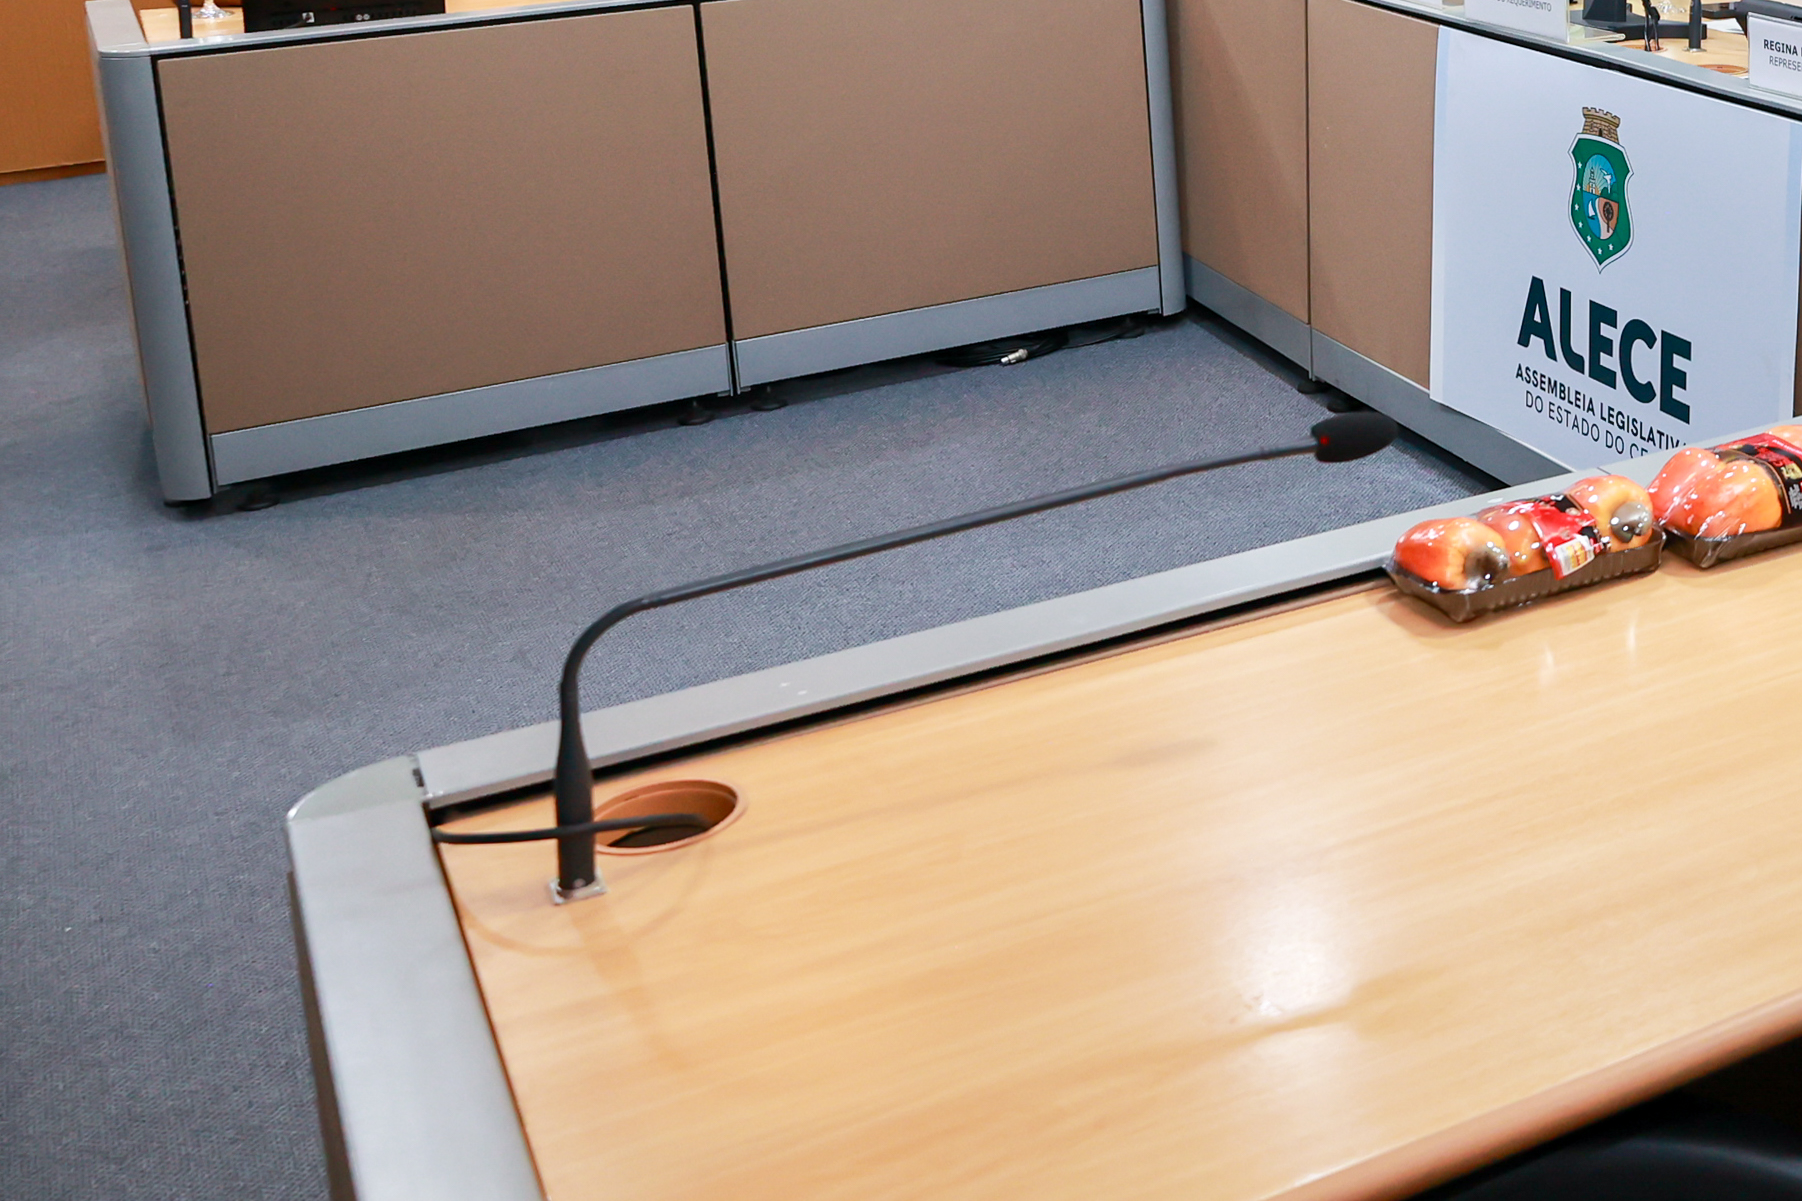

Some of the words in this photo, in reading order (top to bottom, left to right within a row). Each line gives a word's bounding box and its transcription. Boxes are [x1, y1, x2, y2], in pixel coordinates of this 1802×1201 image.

[1763, 38, 1799, 57] REGINA
[1517, 275, 1693, 425] ALECE
[1515, 362, 1596, 417] ASSEMBLEIA
[1599, 401, 1688, 451] LEGISLATIV
[1525, 390, 1544, 414] DO
[1548, 401, 1600, 443] ESTADO
[1605, 429, 1625, 455] DO
